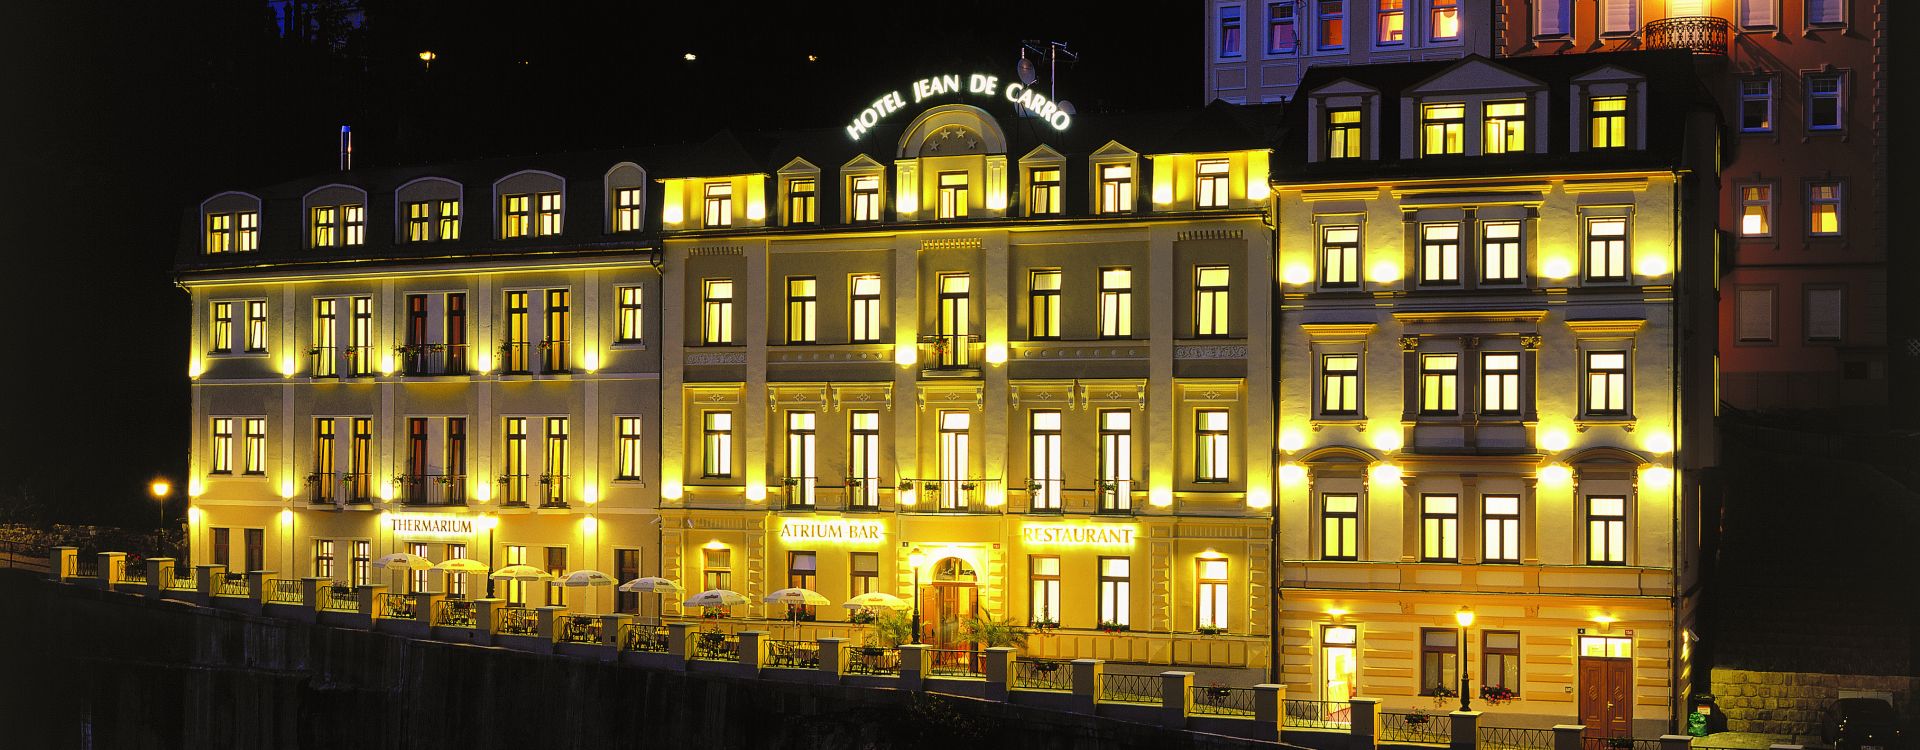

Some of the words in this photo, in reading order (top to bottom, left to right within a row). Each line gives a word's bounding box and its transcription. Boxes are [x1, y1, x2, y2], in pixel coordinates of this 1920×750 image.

[846, 90, 906, 140] HOTEL
[912, 74, 960, 103] JEAN
[969, 74, 998, 95] DE
[1005, 83, 1070, 131] CARRO
[392, 519, 472, 533] THERMARIUM
[780, 523, 842, 538] ATRIUM
[849, 525, 879, 539] BAR
[1023, 527, 1133, 543] RESTAURANT
